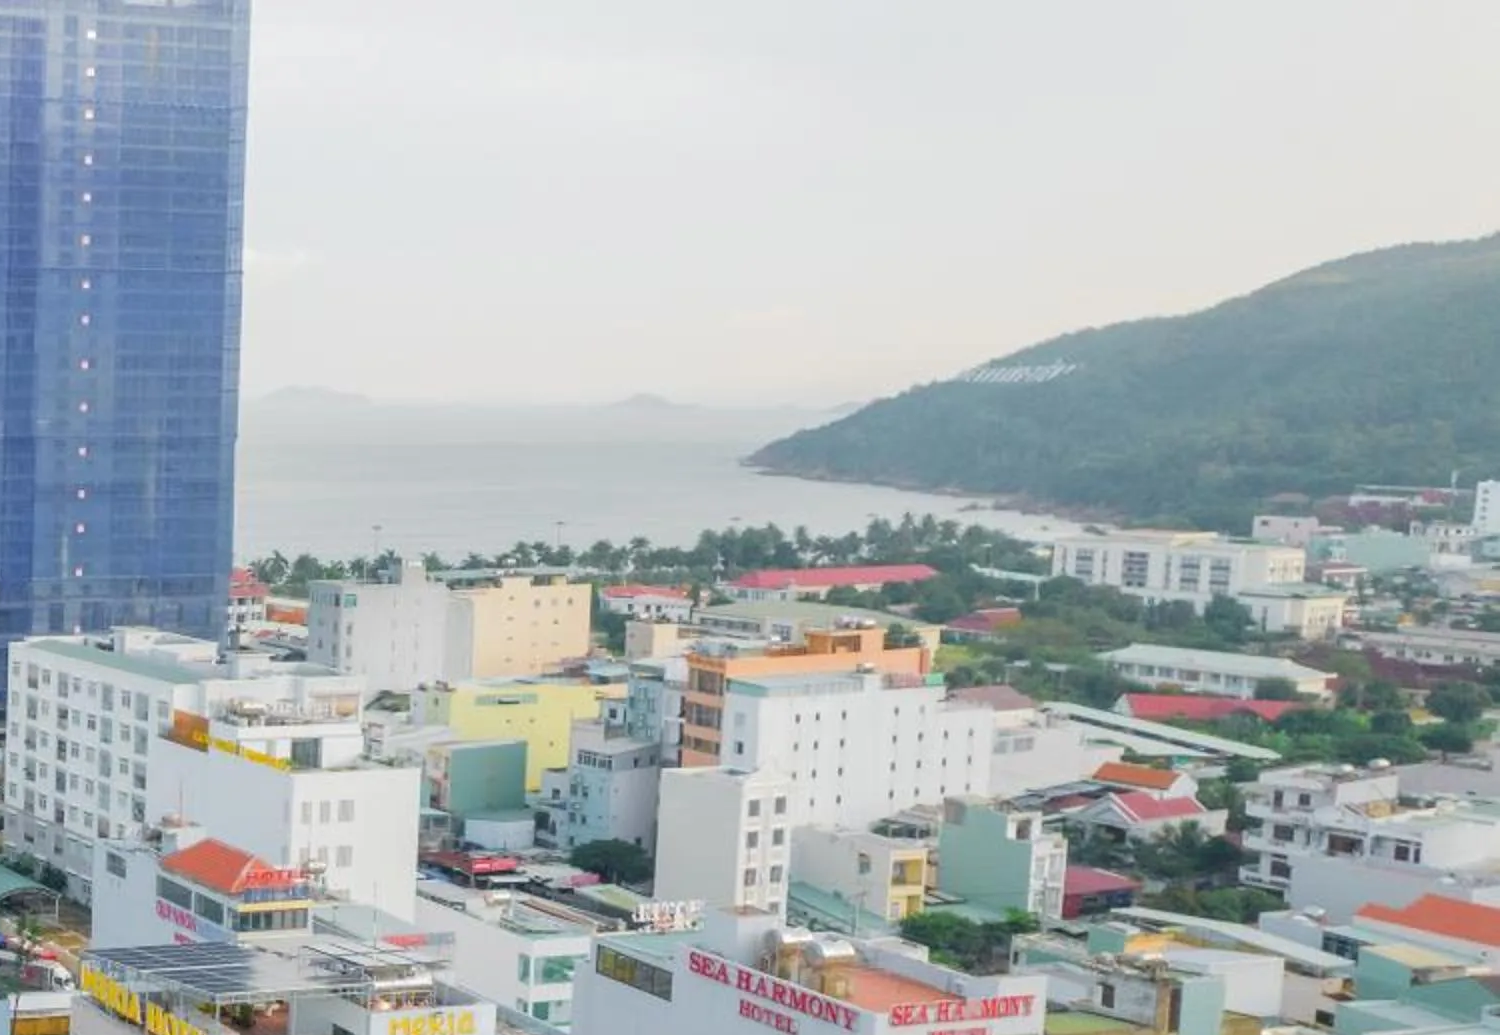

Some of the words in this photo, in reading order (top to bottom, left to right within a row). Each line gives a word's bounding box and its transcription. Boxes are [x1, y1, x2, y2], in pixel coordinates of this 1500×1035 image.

[688, 951, 730, 985] SEA
[736, 968, 861, 1032] HARMONY
[888, 1003, 929, 1027] SEA
[936, 994, 1034, 1022] HAMONY
